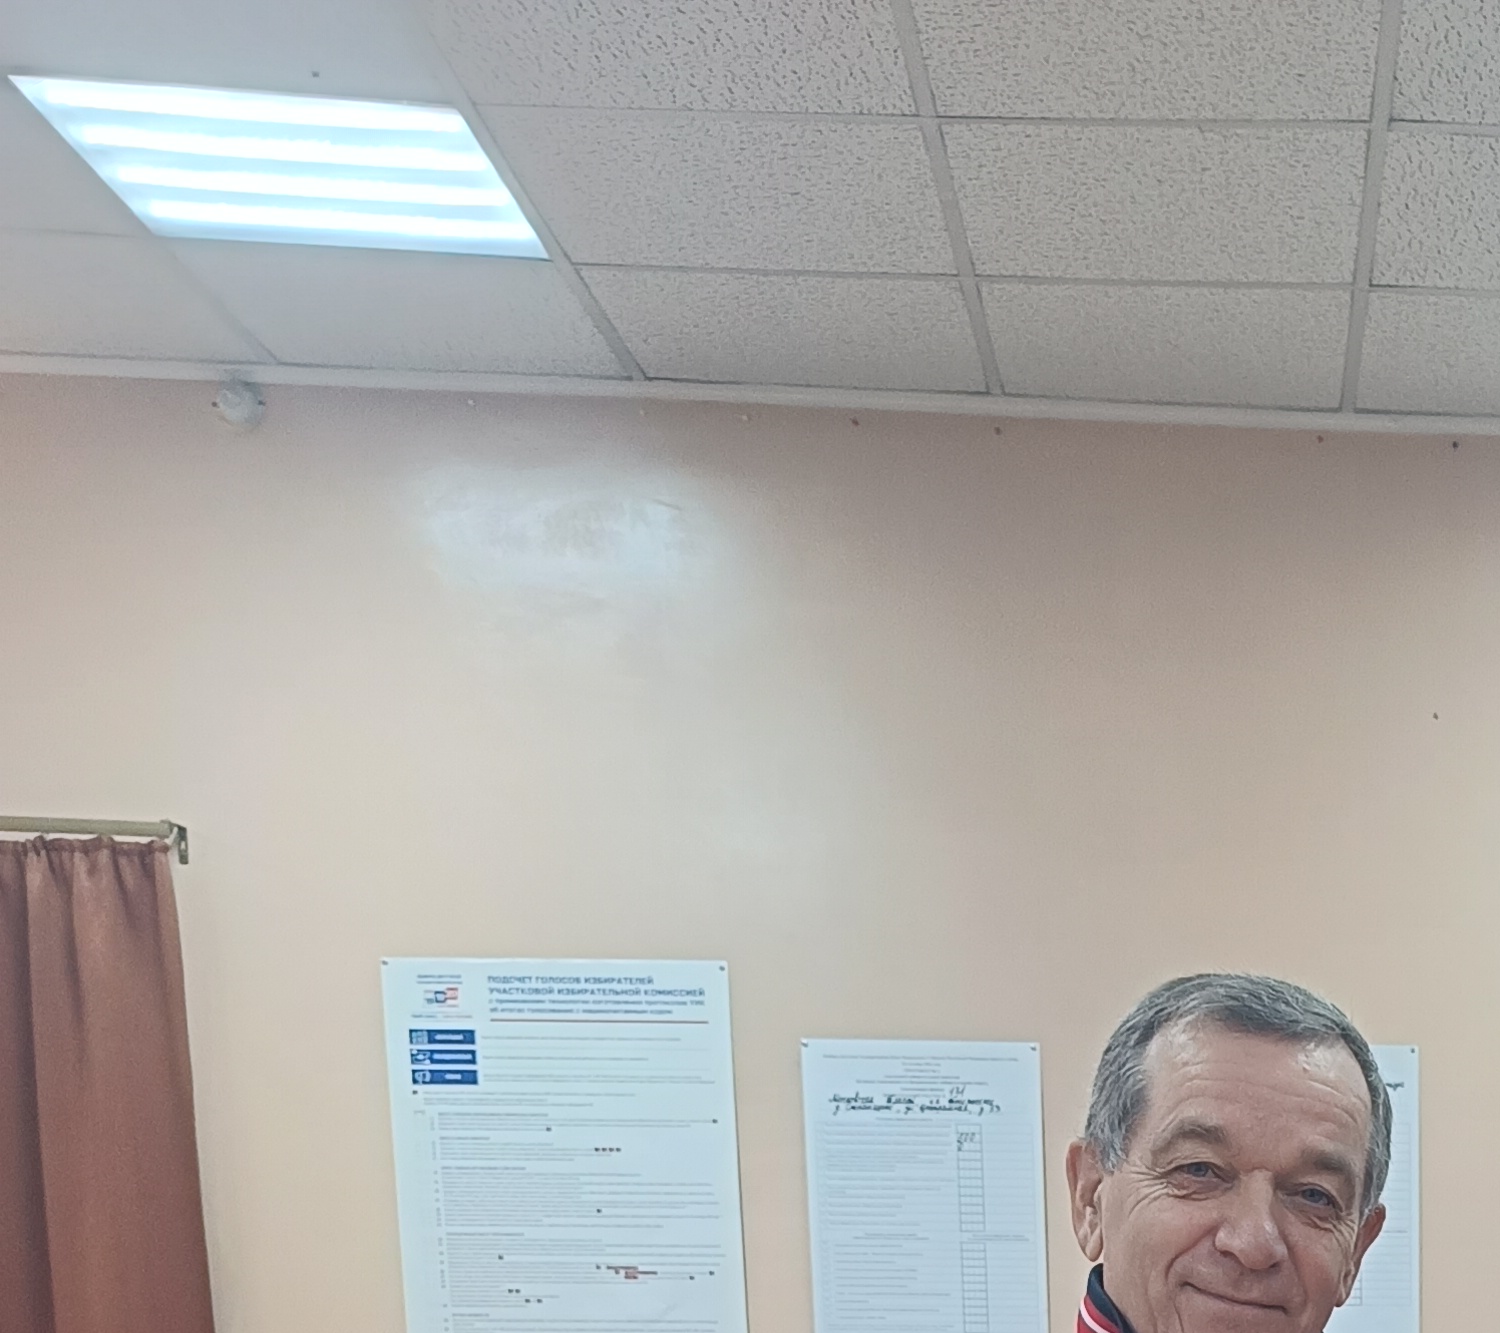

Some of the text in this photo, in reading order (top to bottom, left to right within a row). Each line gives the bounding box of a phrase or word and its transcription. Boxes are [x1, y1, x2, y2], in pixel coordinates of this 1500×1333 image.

[584, 975, 654, 986] ИЗБИРАТЕЛЕЙ
[488, 986, 556, 996] УЧАСТКОВОЙ
[557, 987, 642, 997] ИЗБИРАТЕЛЬНОЙ
